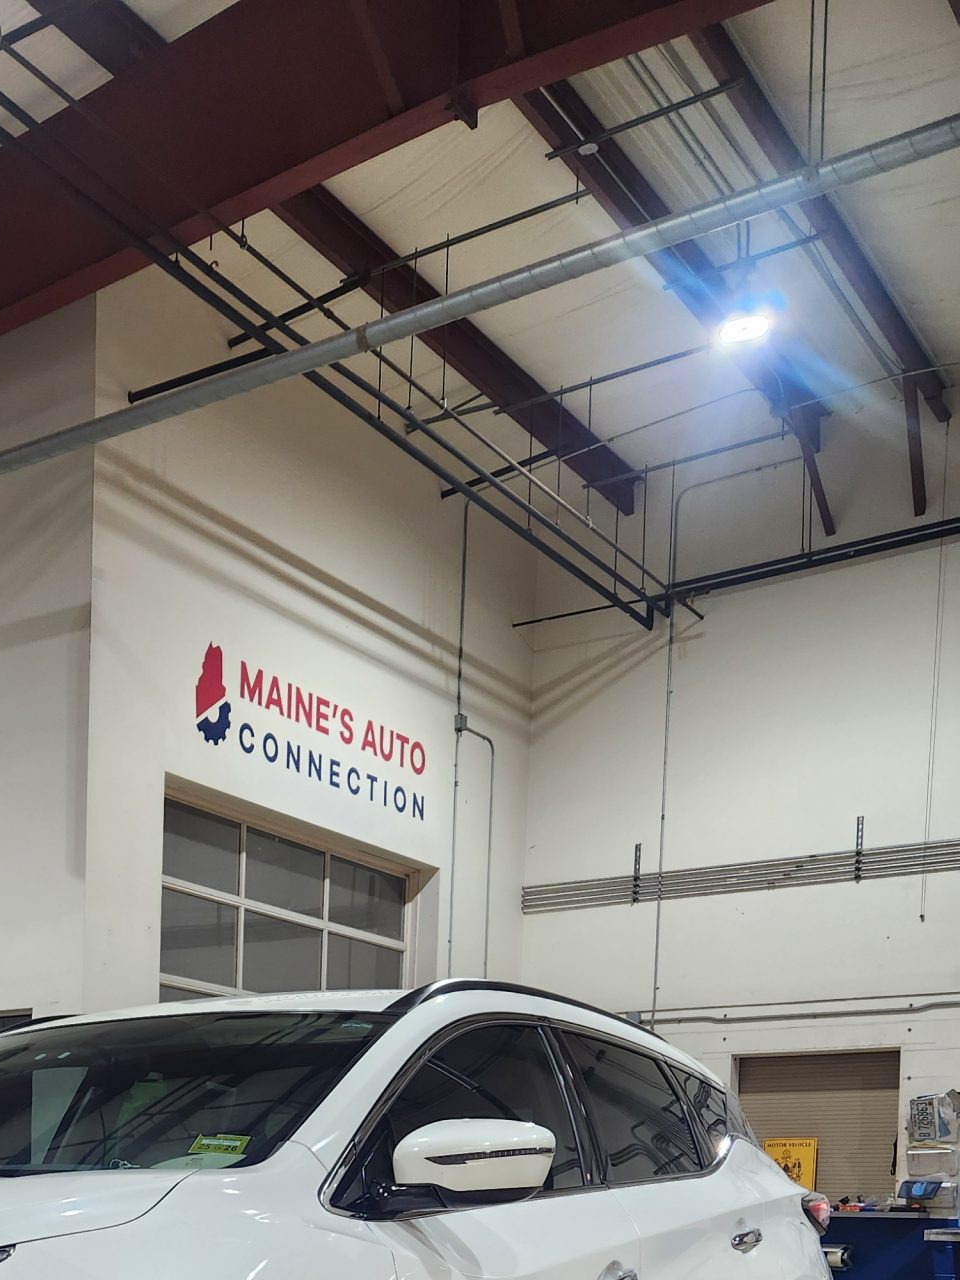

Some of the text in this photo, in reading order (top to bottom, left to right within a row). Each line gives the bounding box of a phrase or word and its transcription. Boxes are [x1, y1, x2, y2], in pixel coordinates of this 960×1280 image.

[239, 722, 425, 821] CONNECTION
[240, 660, 426, 776] MAINE'S AUTO
